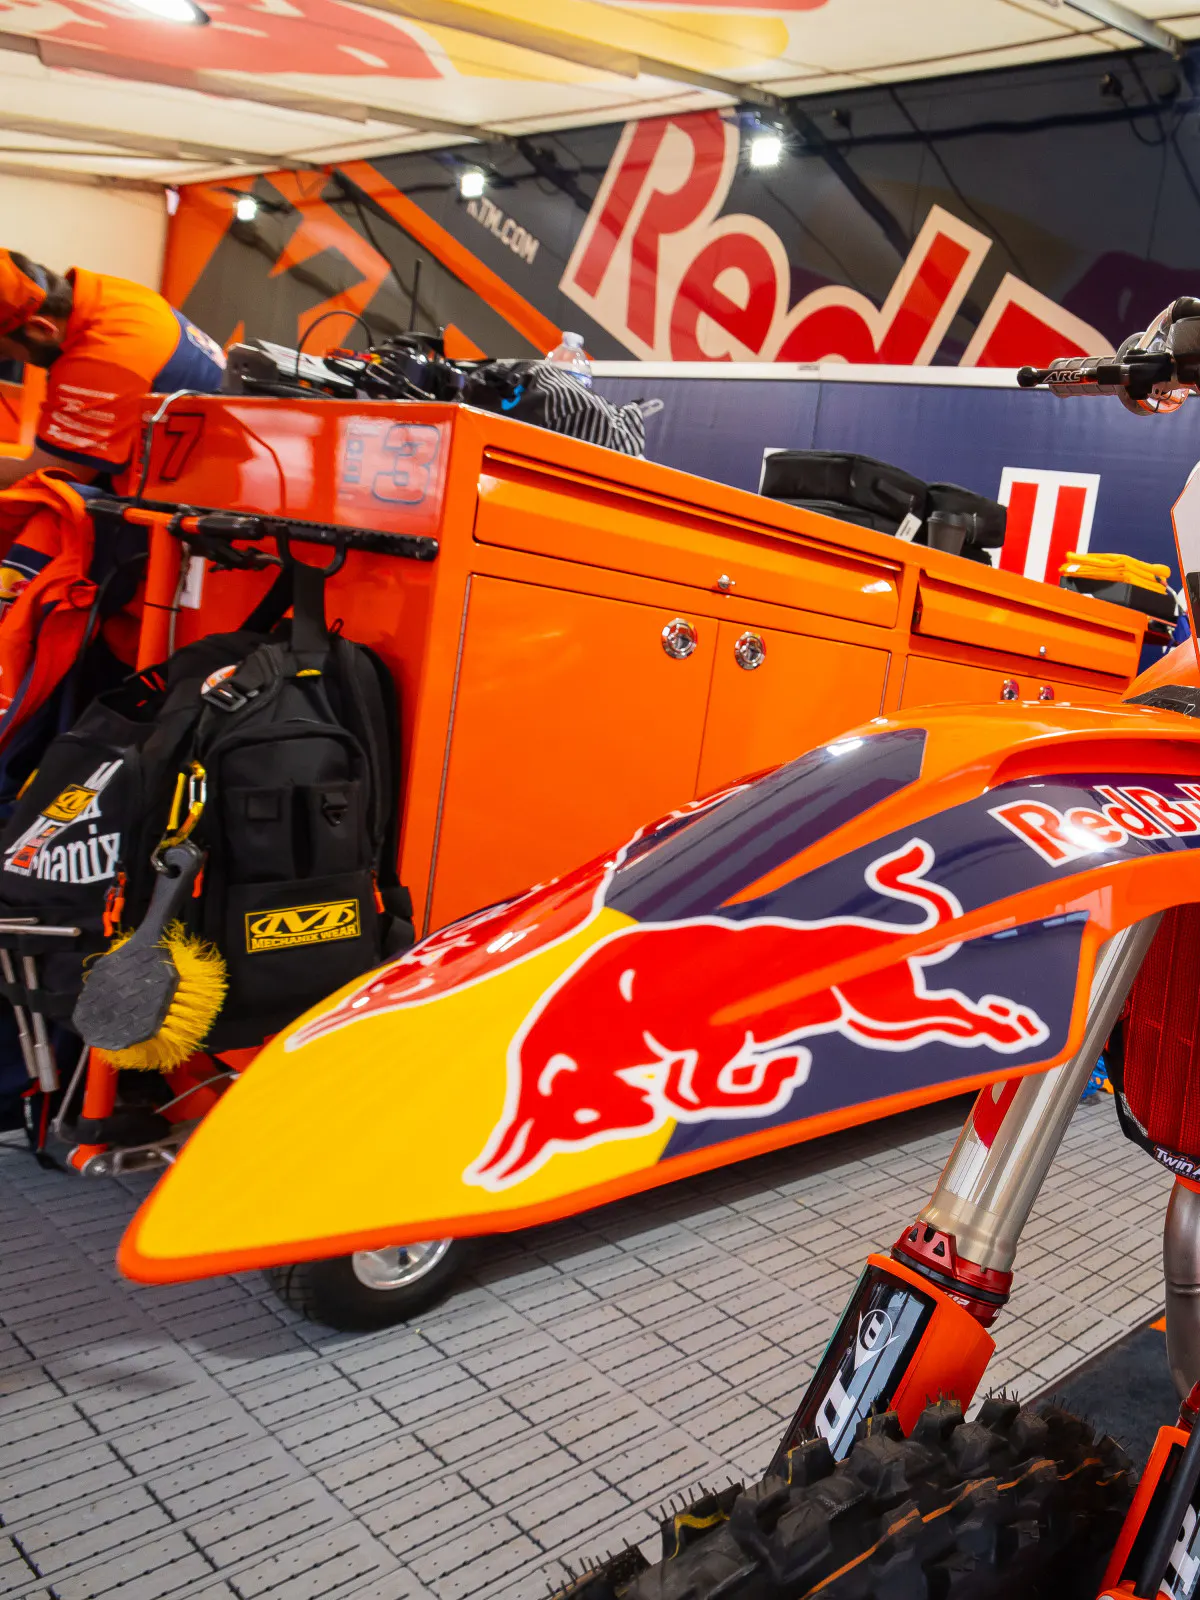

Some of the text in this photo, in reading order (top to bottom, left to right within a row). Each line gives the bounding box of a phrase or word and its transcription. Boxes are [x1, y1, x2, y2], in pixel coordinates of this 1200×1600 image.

[1042, 369, 1082, 384] ARC
[251, 922, 357, 950] MECHANIX WEAR
[1155, 1147, 1195, 1173] Twin
